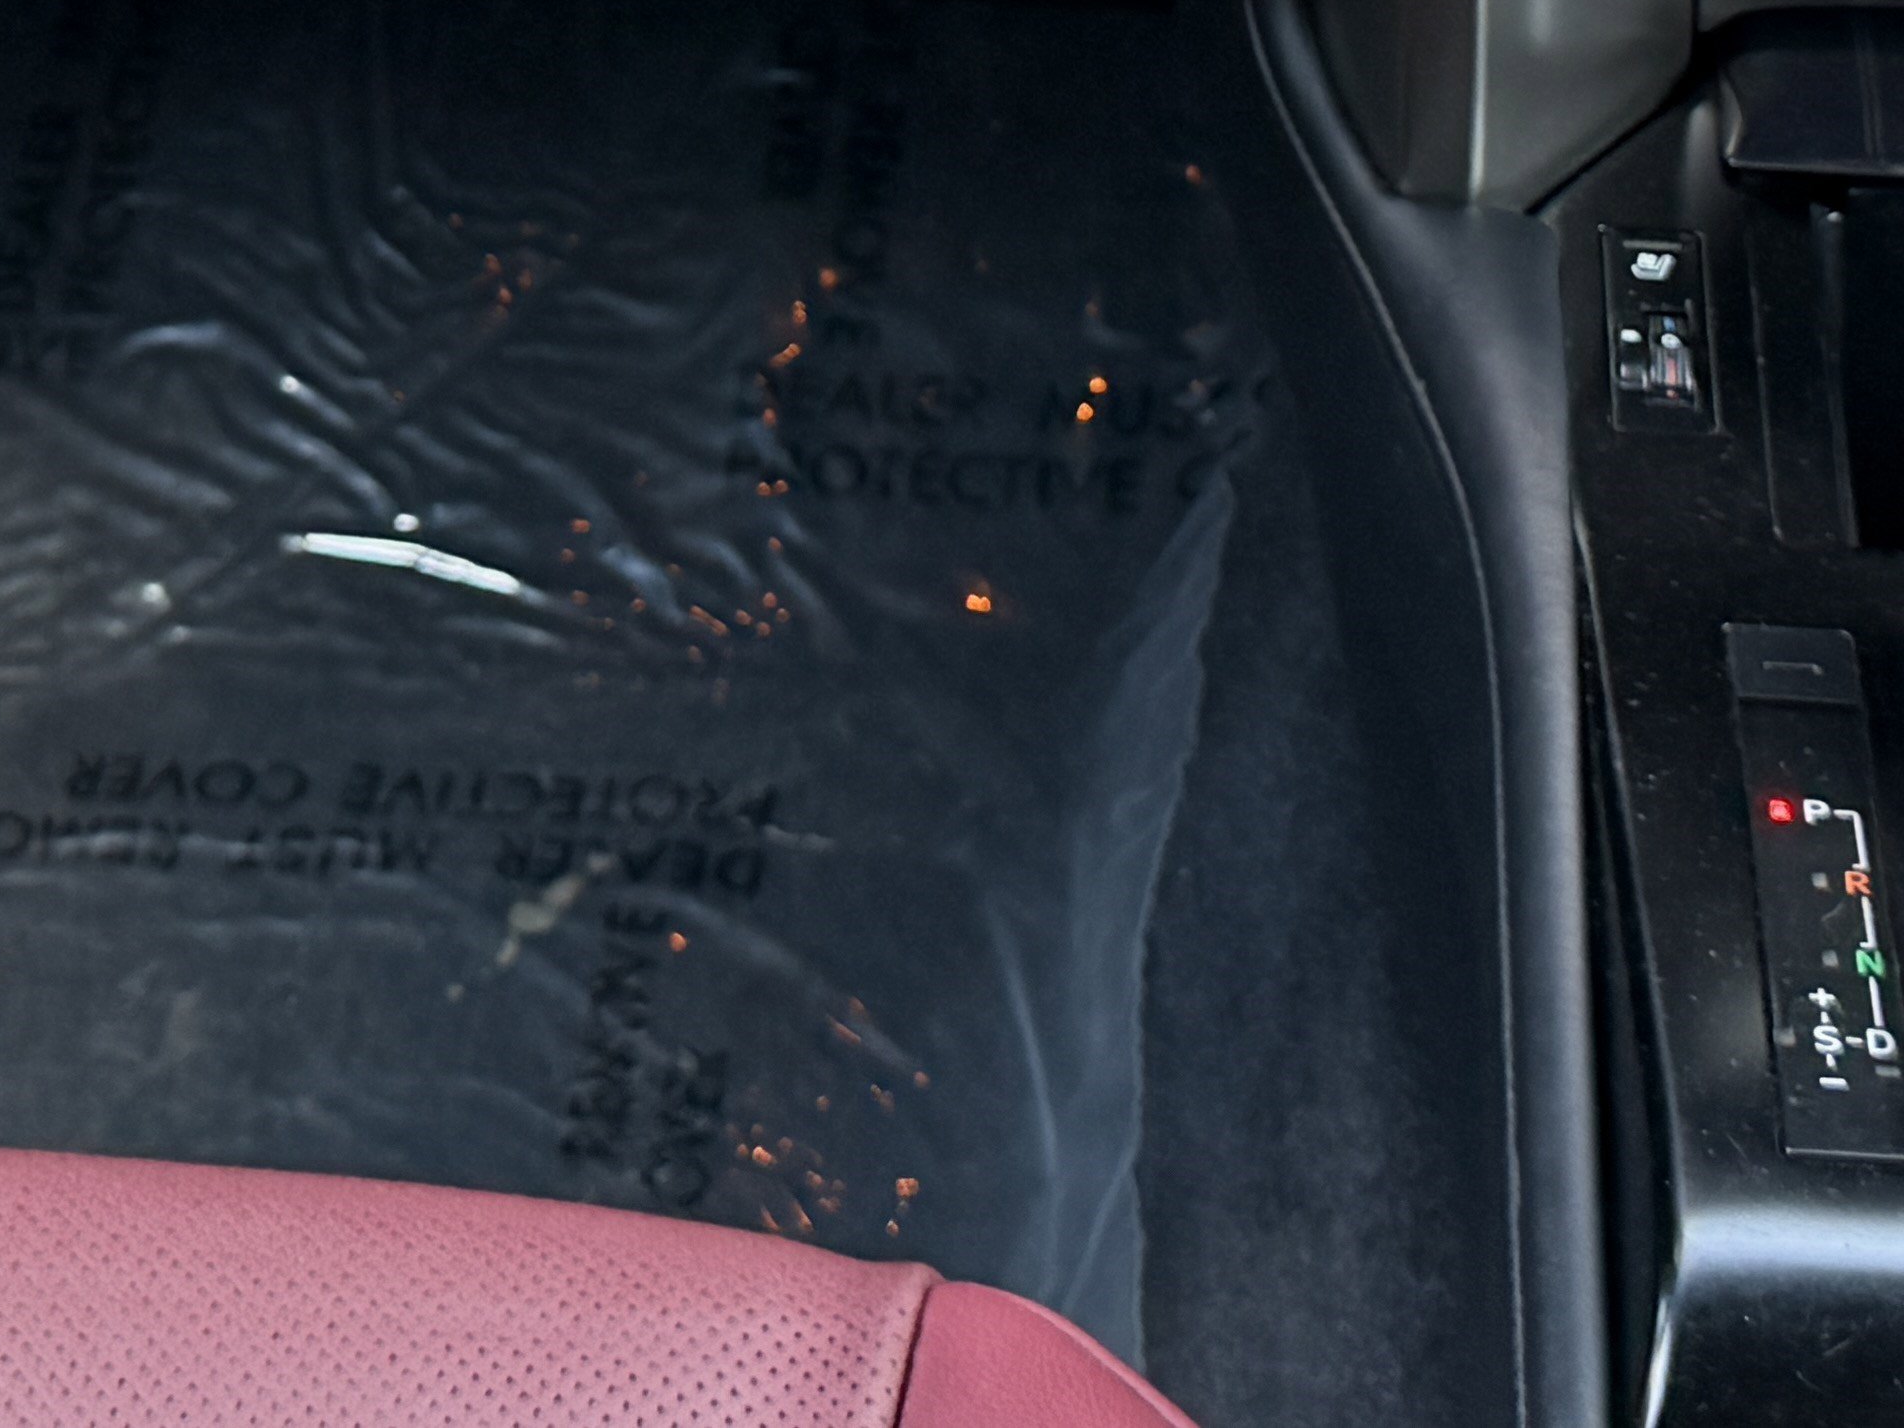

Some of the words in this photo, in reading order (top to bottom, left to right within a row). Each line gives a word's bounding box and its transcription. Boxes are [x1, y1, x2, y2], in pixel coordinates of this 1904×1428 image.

[1803, 798, 1832, 826] P
[1845, 870, 1873, 895] R
[1856, 949, 1886, 978] N
[1813, 1025, 1844, 1055] S
[1866, 1028, 1898, 1061] D
